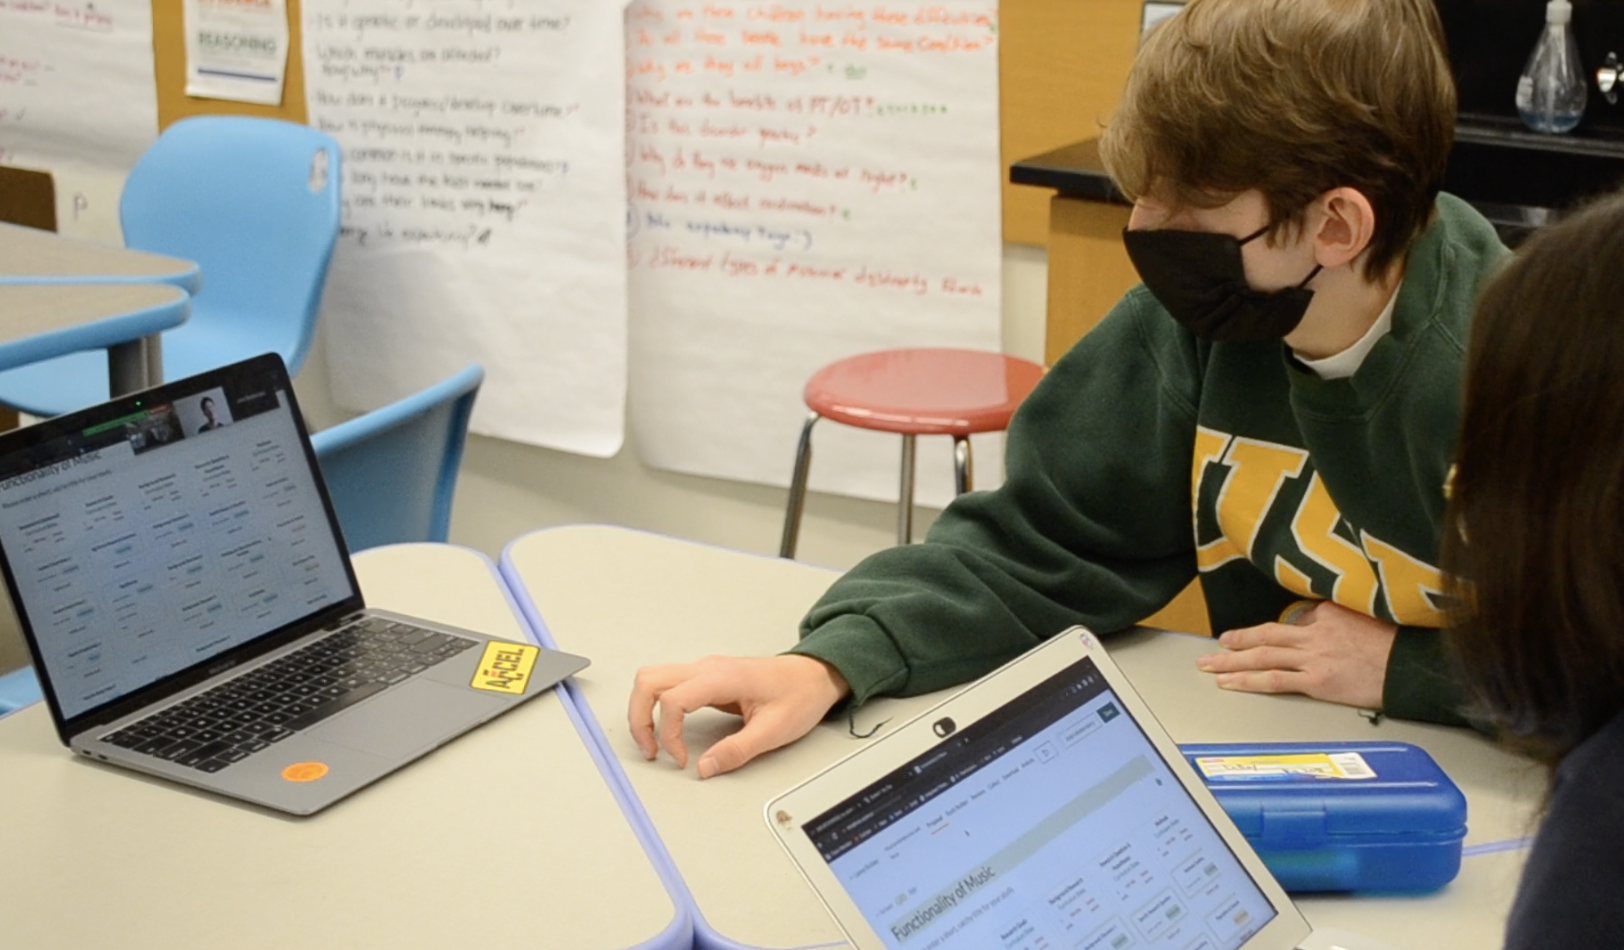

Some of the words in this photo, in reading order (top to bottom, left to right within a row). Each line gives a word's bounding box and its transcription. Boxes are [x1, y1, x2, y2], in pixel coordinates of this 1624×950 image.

[198, 31, 276, 54] REASONING
[0, 464, 60, 491] unctionality
[891, 892, 958, 941] Functionality
[955, 880, 968, 899] of
[964, 866, 996, 892] Music
